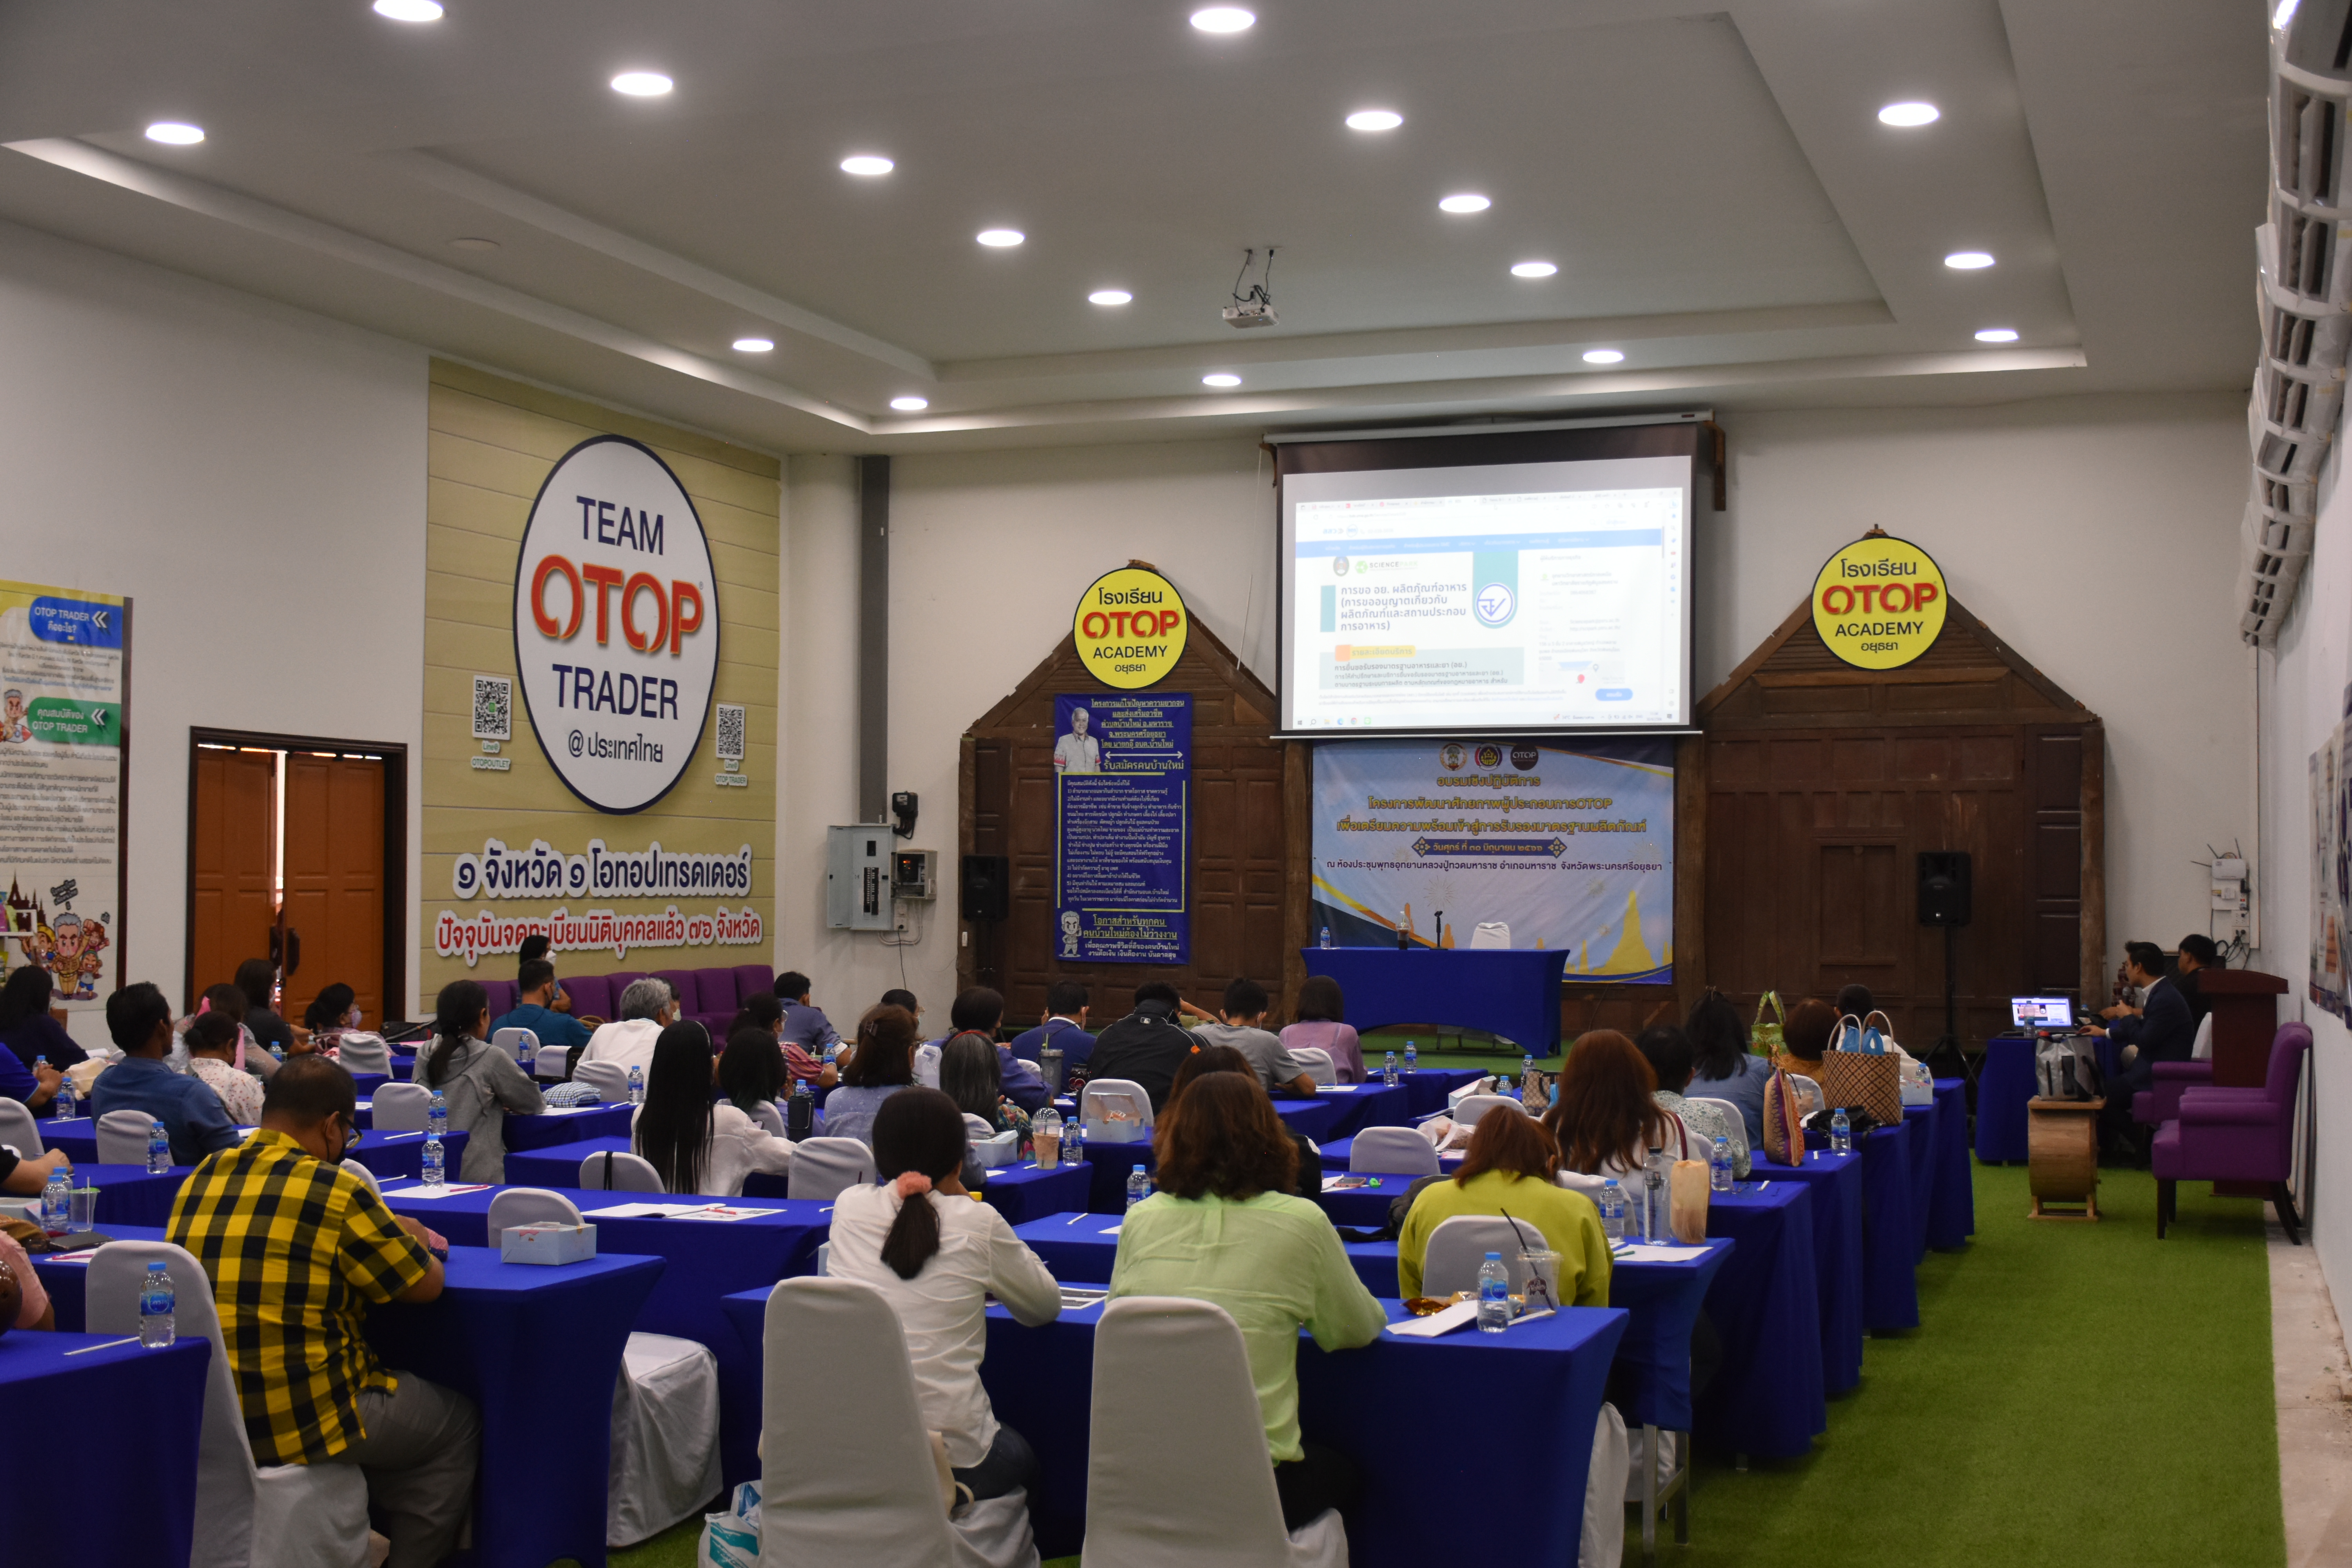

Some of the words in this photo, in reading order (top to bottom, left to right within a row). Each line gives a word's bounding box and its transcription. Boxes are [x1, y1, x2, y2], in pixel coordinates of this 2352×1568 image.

[577, 495, 663, 555] TEAM
[1840, 558, 1916, 578] โรงเรียน
[1374, 586, 1389, 594] อย.
[1393, 583, 1467, 593] ผลิตภัณฑ์อาหาร
[1098, 587, 1163, 605] โรงเรียน
[1341, 595, 1448, 608] (การขออนุญาตเกี่ยวกับ
[1822, 583, 1938, 614] OTOP
[531, 554, 703, 655] OTOP
[34, 607, 57, 617] OTOP
[58, 610, 90, 621] TRADER
[1341, 607, 1466, 619] ผลิตภัณฑ์และสถานประกอบ
[48, 620, 77, 633] คืออะไร?
[1082, 610, 1180, 639] OTOP
[1341, 621, 1390, 631] การอาหาร)
[1835, 621, 1924, 637] ACADEMY
[1093, 645, 1168, 659] ACADEMY
[1352, 648, 1412, 656] รายละเอียดบริการ
[1861, 642, 1898, 653] อยุธยา
[1114, 664, 1146, 675] อยุธยา
[552, 664, 678, 720] TRADER
[1091, 698, 1184, 707] โครงการแก้ไขปัญหาความยากจน
[38, 708, 84, 720] คุณสมบัติของ
[1112, 709, 1163, 717] และส่งเสริมอาชีพ
[32, 721, 54, 731] OTOP
[56, 722, 88, 733] TRADER
[1109, 730, 1166, 738] จ.พระนครศรีอยุธยา
[569, 730, 584, 758] @
[588, 731, 663, 763] ประเทศไทย
[472, 758, 509, 768] OTOPOUTLET
[1104, 760, 1184, 770] รับสมัครคนบ้านใหม่
[1437, 774, 1541, 789] อบรมเชิงปฏิบัติการ
[1368, 796, 1612, 813] โครงการพัฒนาศักยภาพผู้ประกอบการOTOP
[1337, 817, 1647, 836] เพื่อเตรียมความพร้อมเข้าสู่การรับรองมาตรฐานผลิตภัณฑ์
[1433, 844, 1460, 854] วันศุกร์
[1483, 842, 1515, 853] มิถุนายน
[458, 862, 475, 889] ๑
[486, 848, 562, 889] จังหวัด
[570, 863, 584, 888] ๑
[592, 848, 748, 889] โอทอปเทรดเดอร์
[1338, 859, 1497, 872] ห้องประชุมพุทธอุทยานหลวงปู่ทวดมหาราช
[1500, 860, 1557, 870] อำเภอมหาราช
[1561, 861, 1662, 873] จังหวัดพระนครศรีอยุธยา
[689, 922, 712, 938] ๗๖
[718, 912, 760, 938] จังหวัด
[1093, 914, 1165, 927] โอกาสสำหรับทุกคน
[1083, 927, 1177, 938] คนบ้านใหม่ต้องไม่ว่างงาน
[1085, 940, 1180, 951] เพื่อคุณภาพชีวิตที่ดีของคนบ้านใหม่
[1148, 951, 1176, 960] บันดาลสุข
